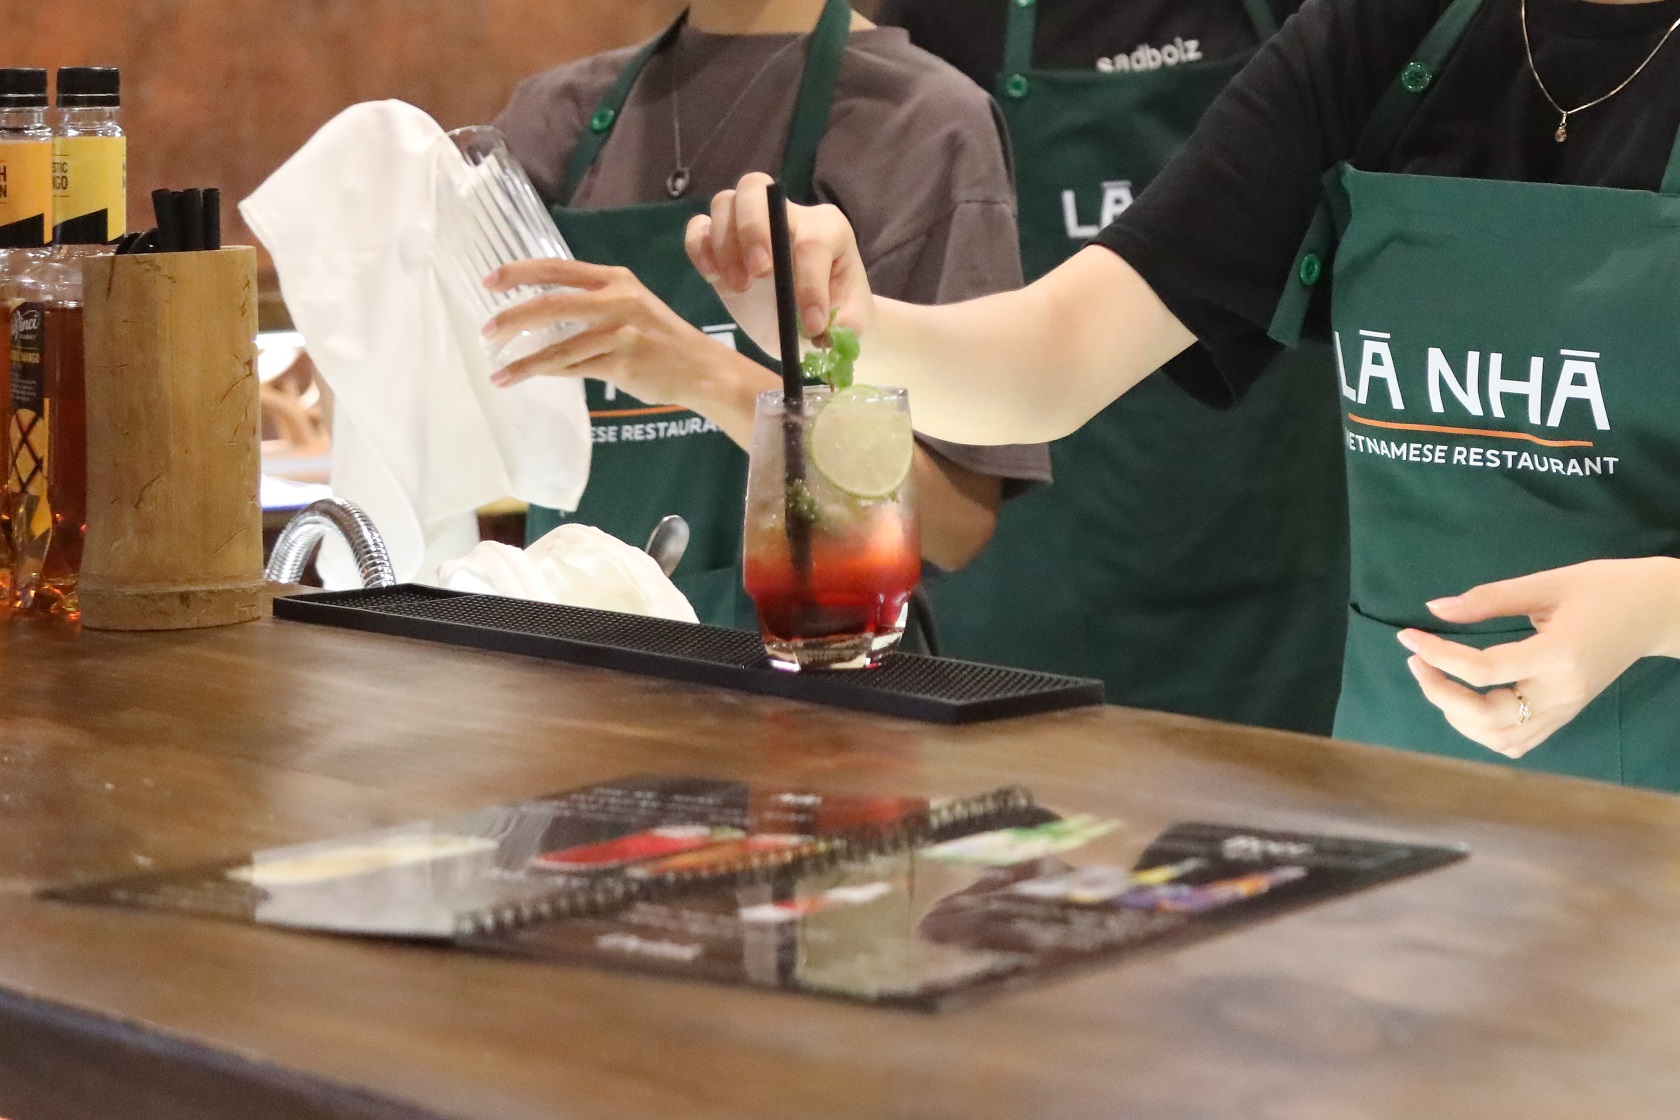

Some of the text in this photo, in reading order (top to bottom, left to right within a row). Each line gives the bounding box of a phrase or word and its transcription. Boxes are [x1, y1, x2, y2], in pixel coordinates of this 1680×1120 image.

[622, 416, 720, 442] RESTAURA
[1345, 427, 1619, 476] IETNAMESE RESTAURANT
